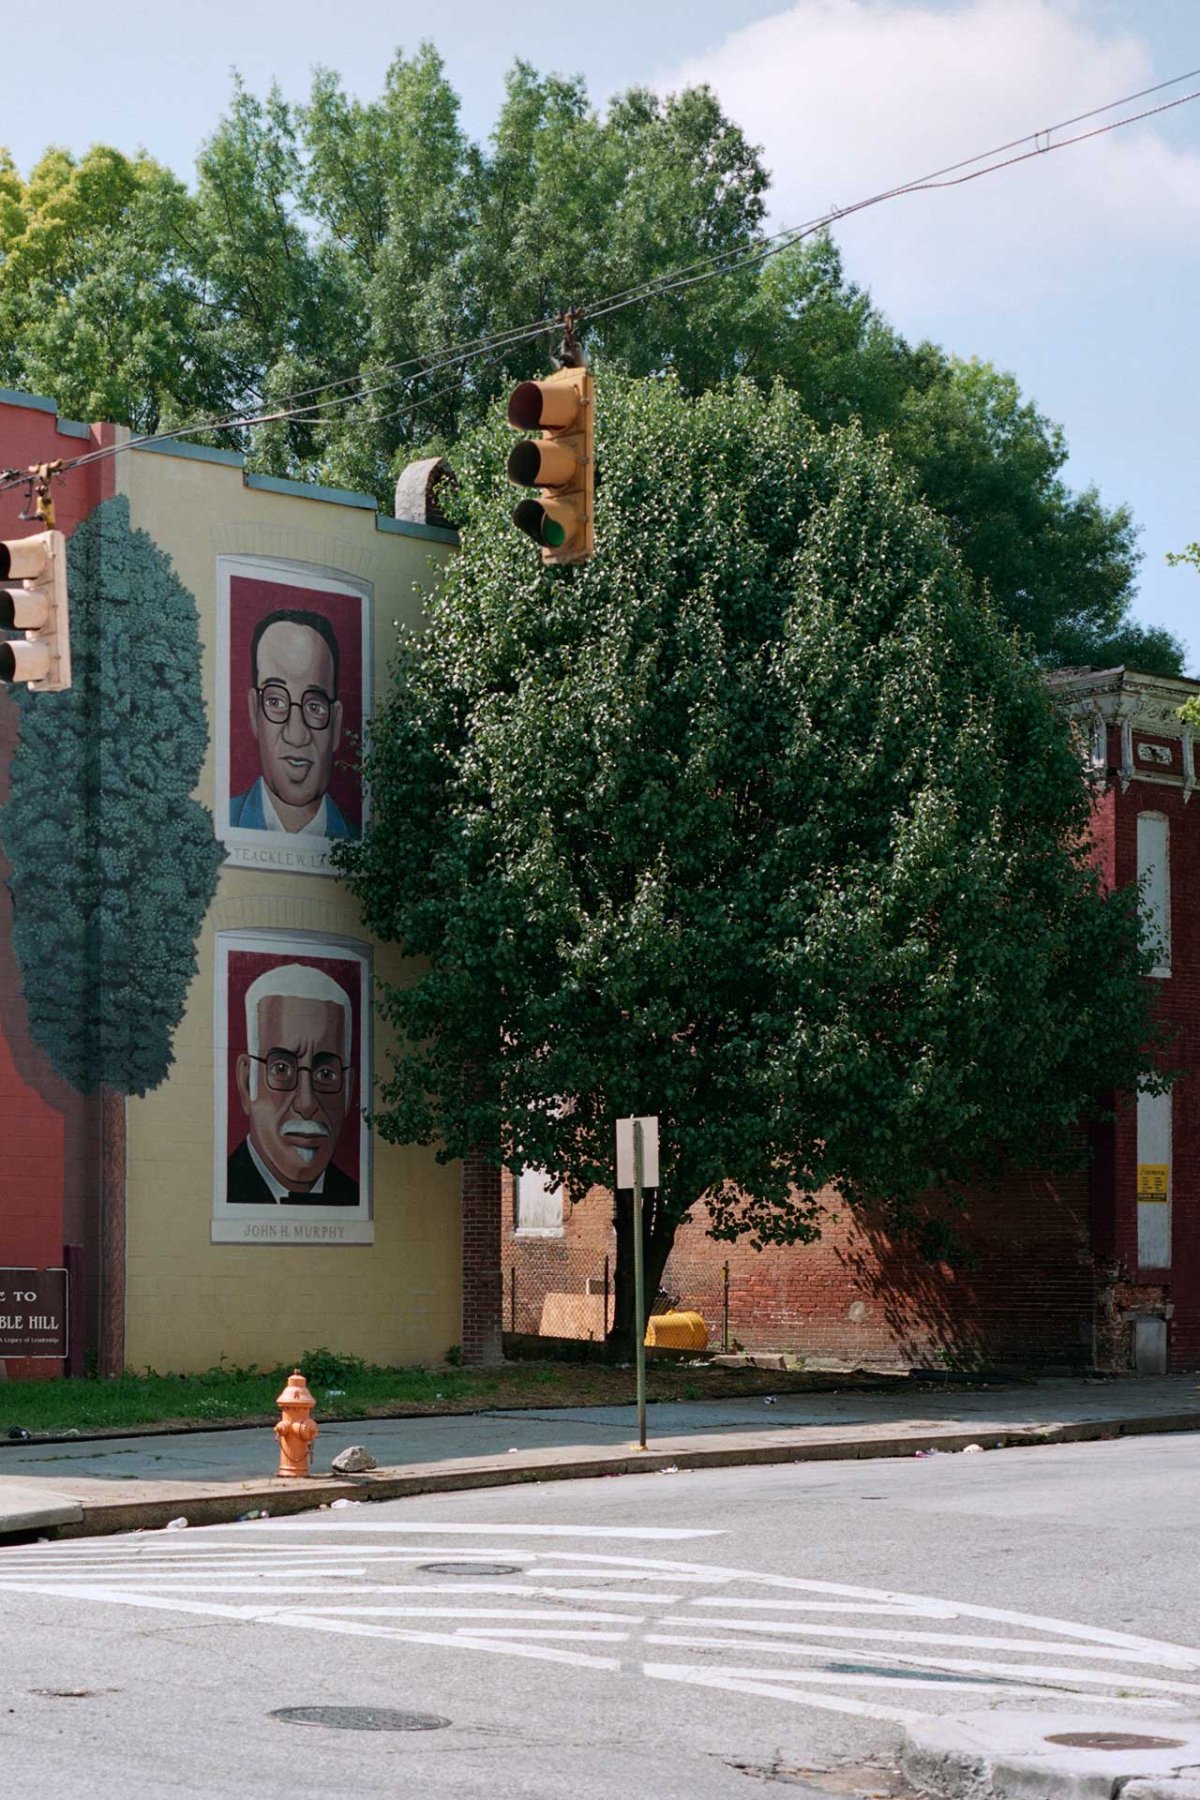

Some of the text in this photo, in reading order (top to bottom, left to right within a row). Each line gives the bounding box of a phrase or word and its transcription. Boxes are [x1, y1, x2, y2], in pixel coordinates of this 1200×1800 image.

[233, 847, 293, 866] TEACKLE
[243, 1223, 277, 1238] JOHN
[294, 1225, 345, 1239] MURPHY
[13, 1291, 37, 1302] TO
[28, 1315, 59, 1330] HILL
